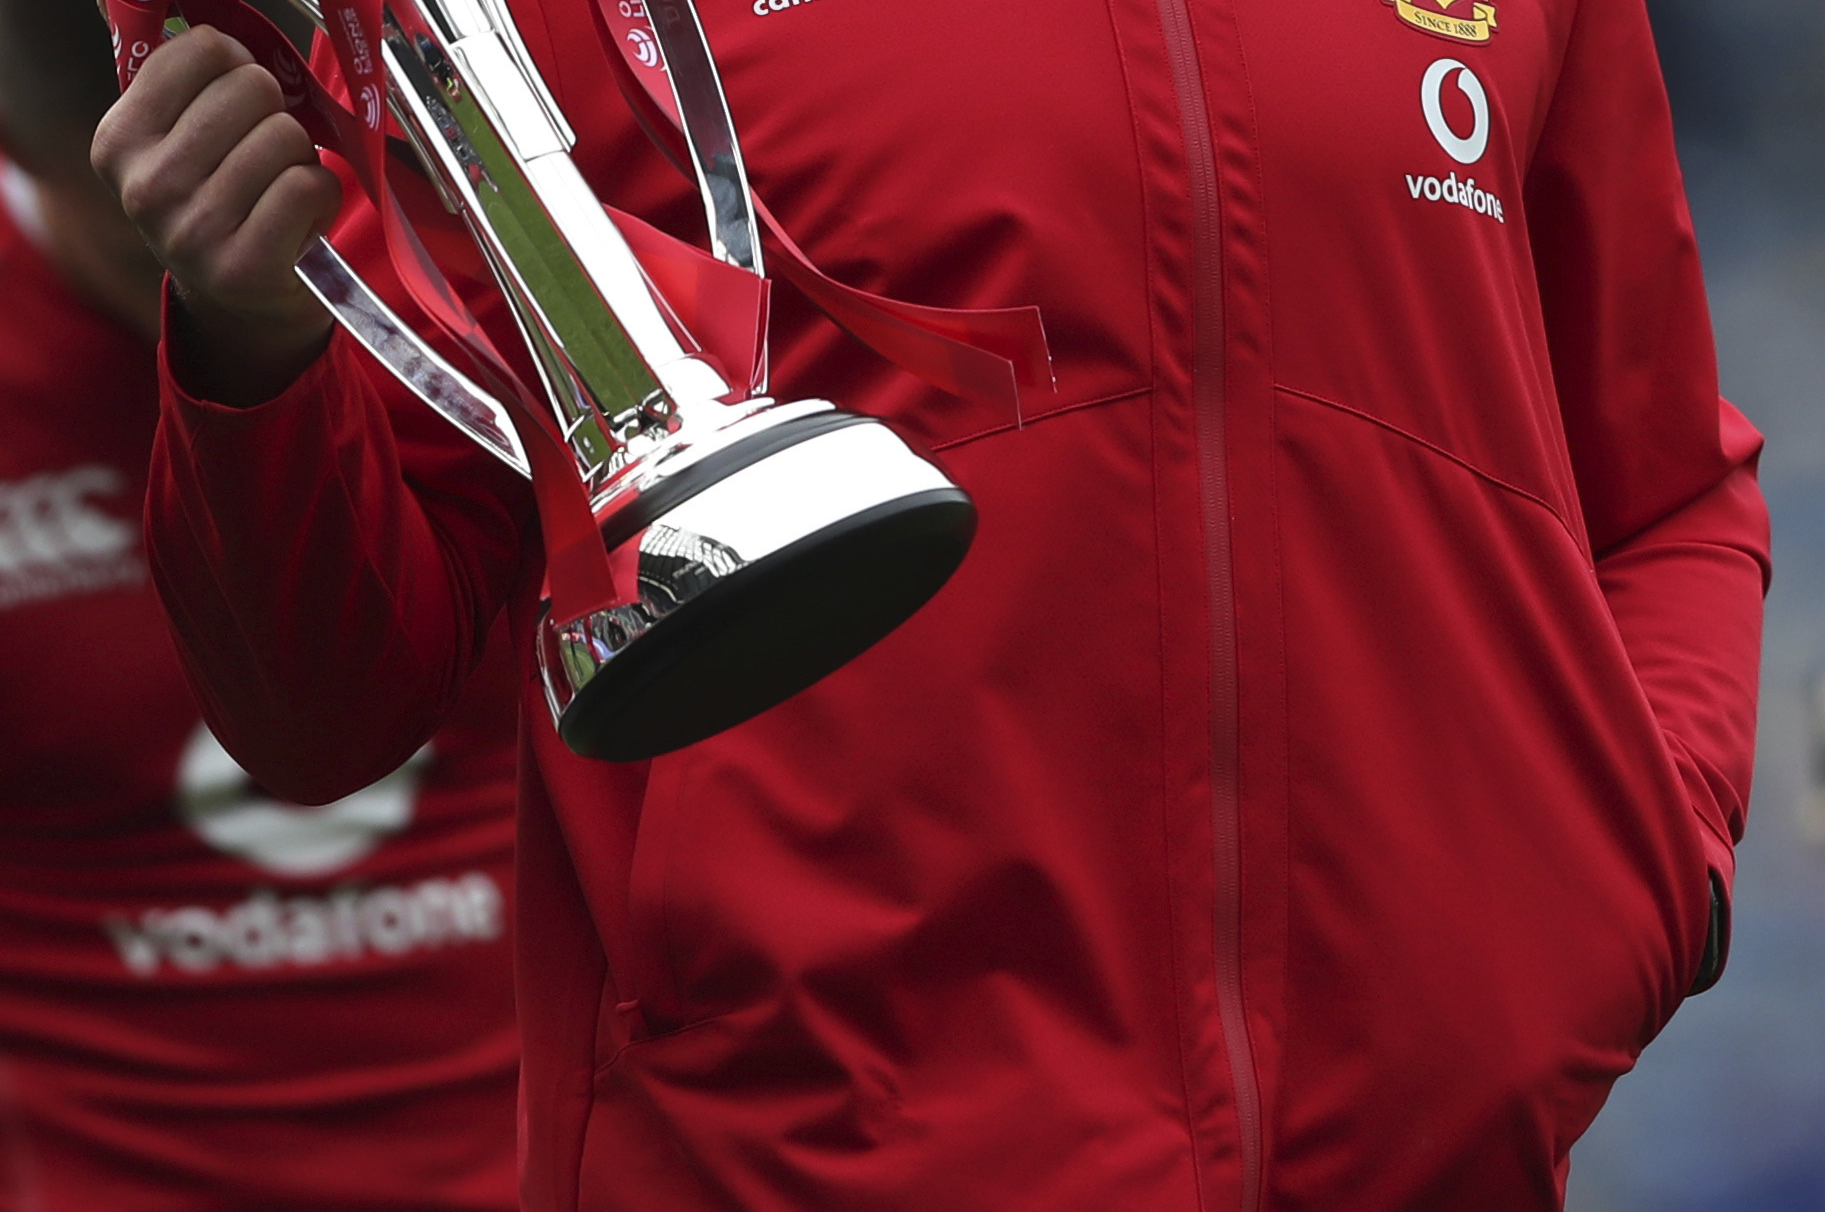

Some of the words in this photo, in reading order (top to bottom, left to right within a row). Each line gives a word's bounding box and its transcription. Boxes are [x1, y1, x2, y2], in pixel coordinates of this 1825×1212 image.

[1414, 10, 1452, 32] SINCE
[1453, 21, 1478, 38] 1888
[1405, 171, 1505, 224] vodafone
